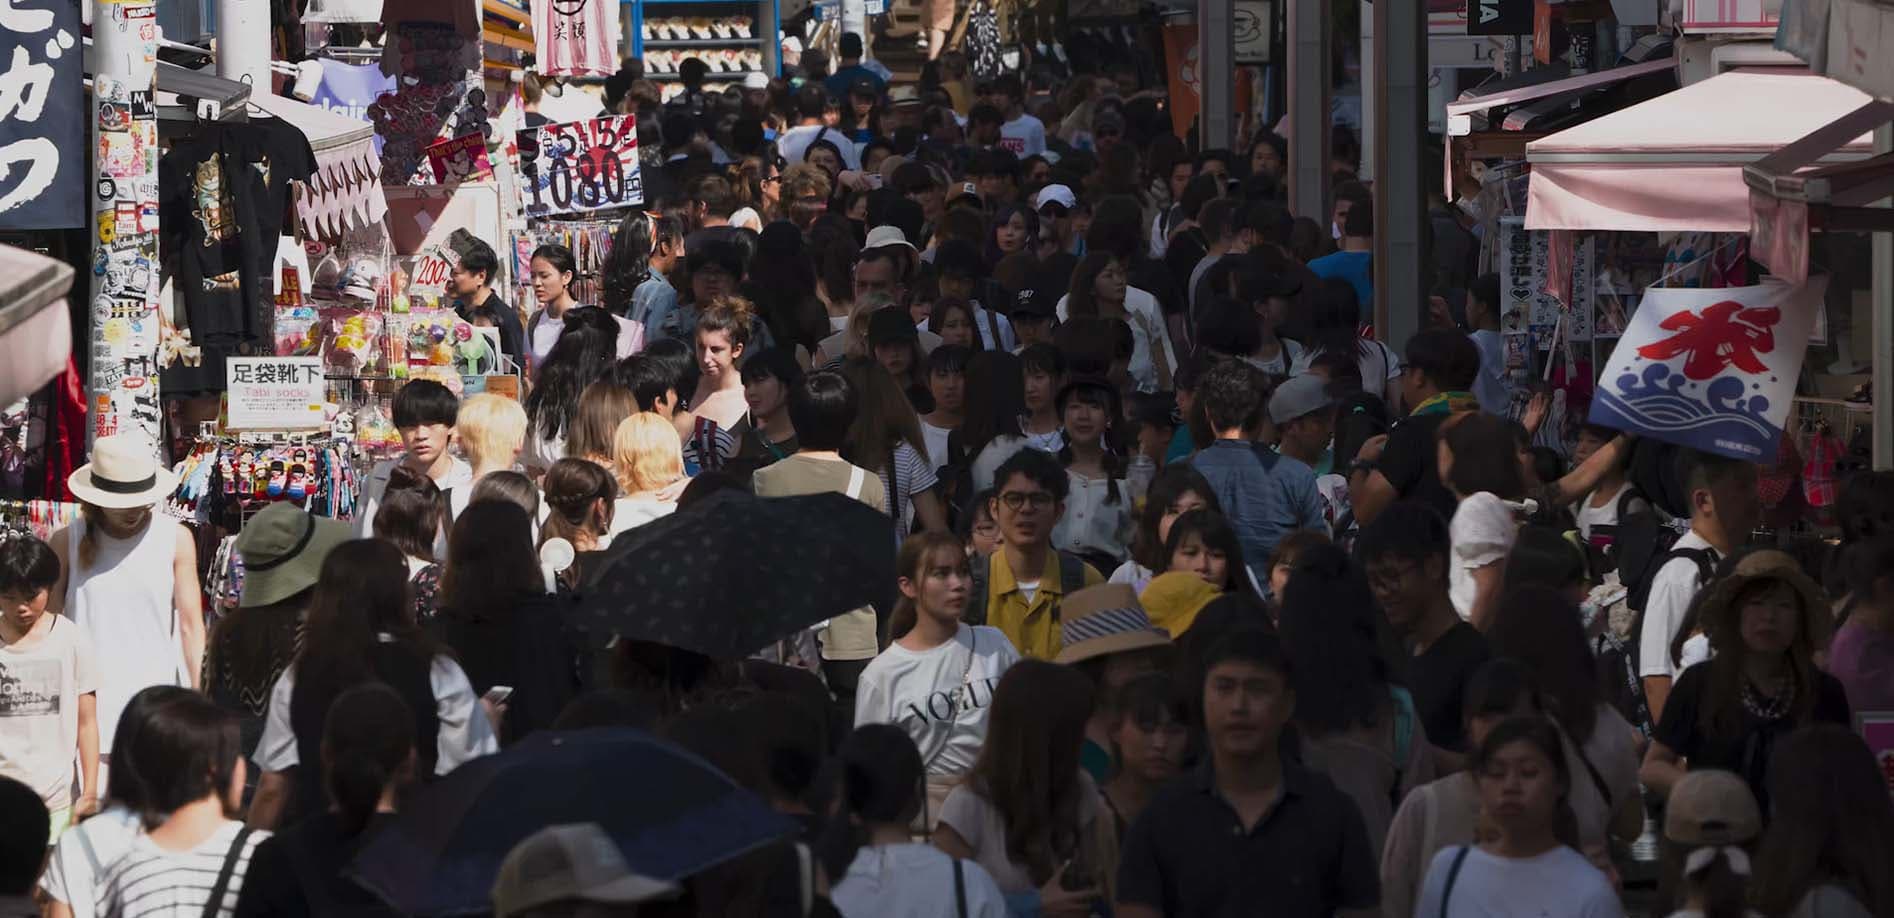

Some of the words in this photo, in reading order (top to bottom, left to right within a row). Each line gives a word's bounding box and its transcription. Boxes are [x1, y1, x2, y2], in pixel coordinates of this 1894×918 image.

[1001, 137, 1024, 153] ANS
[232, 363, 320, 384] 足袋靴下
[243, 386, 271, 398] Tabi
[908, 677, 1001, 725] VOGU
